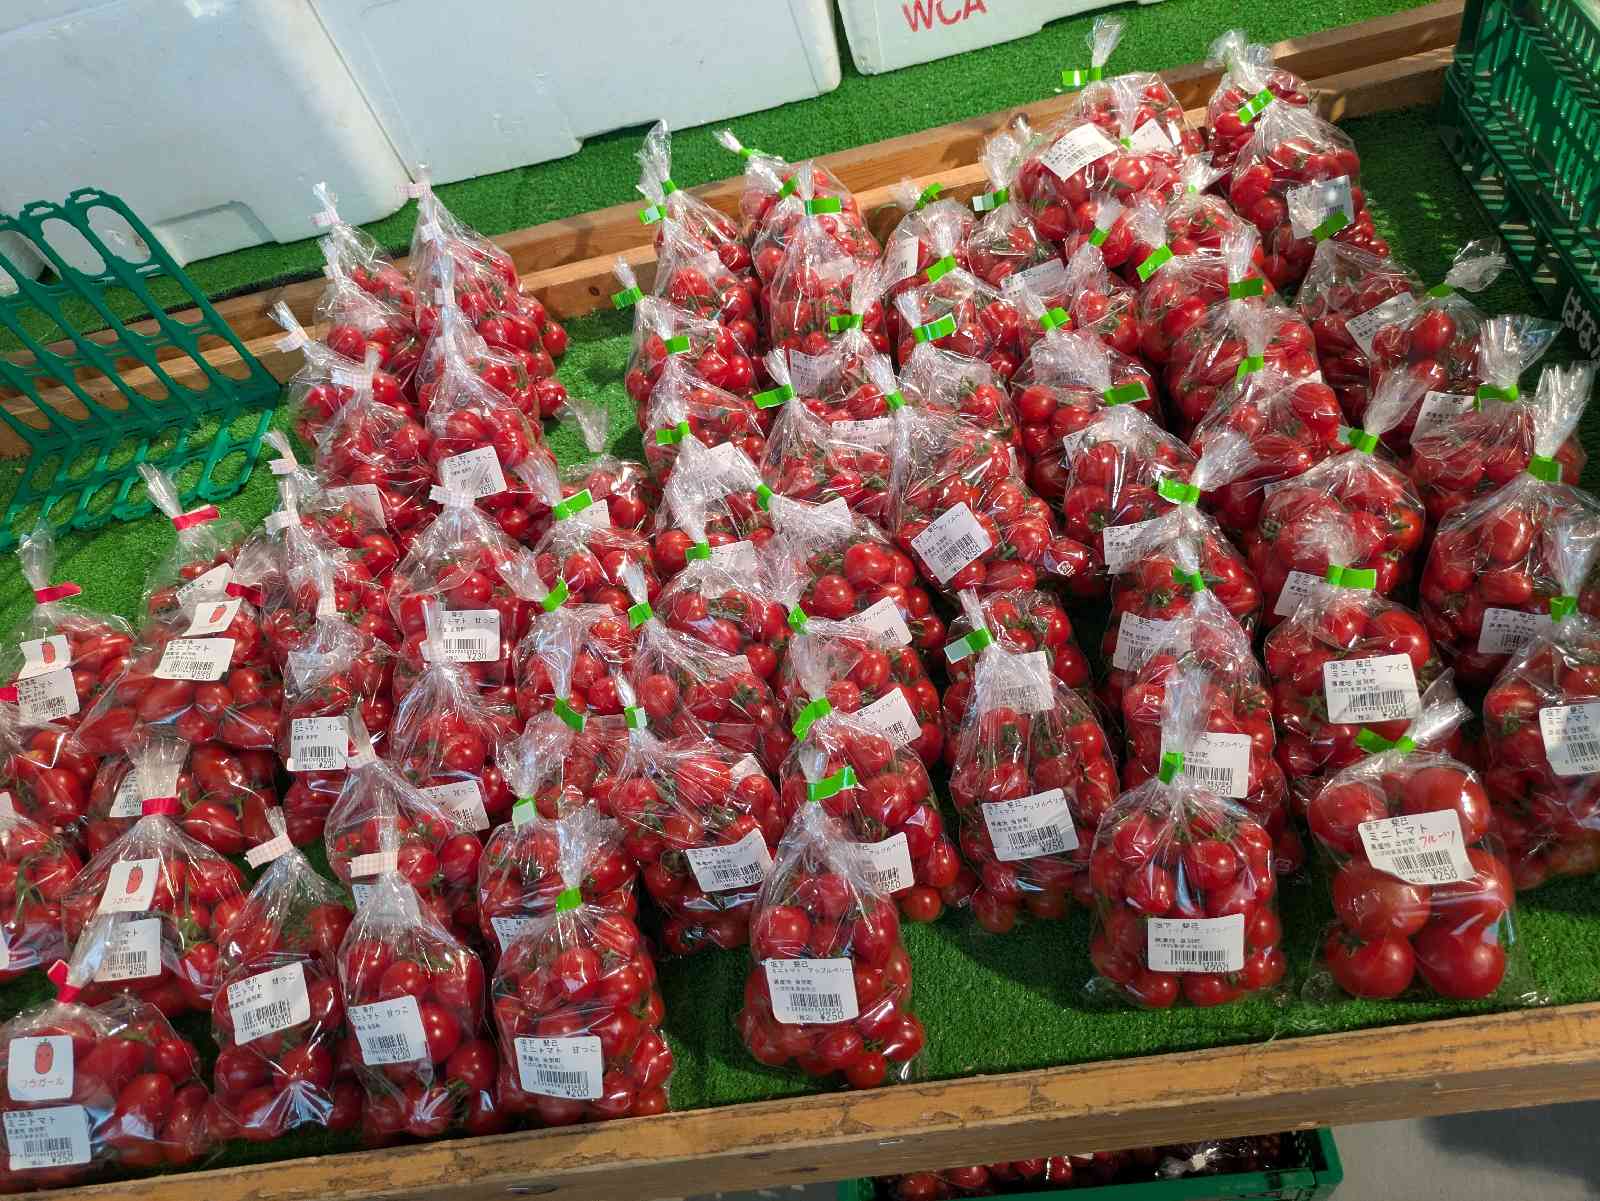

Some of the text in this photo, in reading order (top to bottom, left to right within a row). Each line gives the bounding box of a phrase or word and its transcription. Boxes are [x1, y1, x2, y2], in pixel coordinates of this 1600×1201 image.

[1328, 668, 1376, 677] ミニトマト
[1369, 824, 1428, 841] ミニトマト
[8, 1116, 56, 1127] ミニトマト
